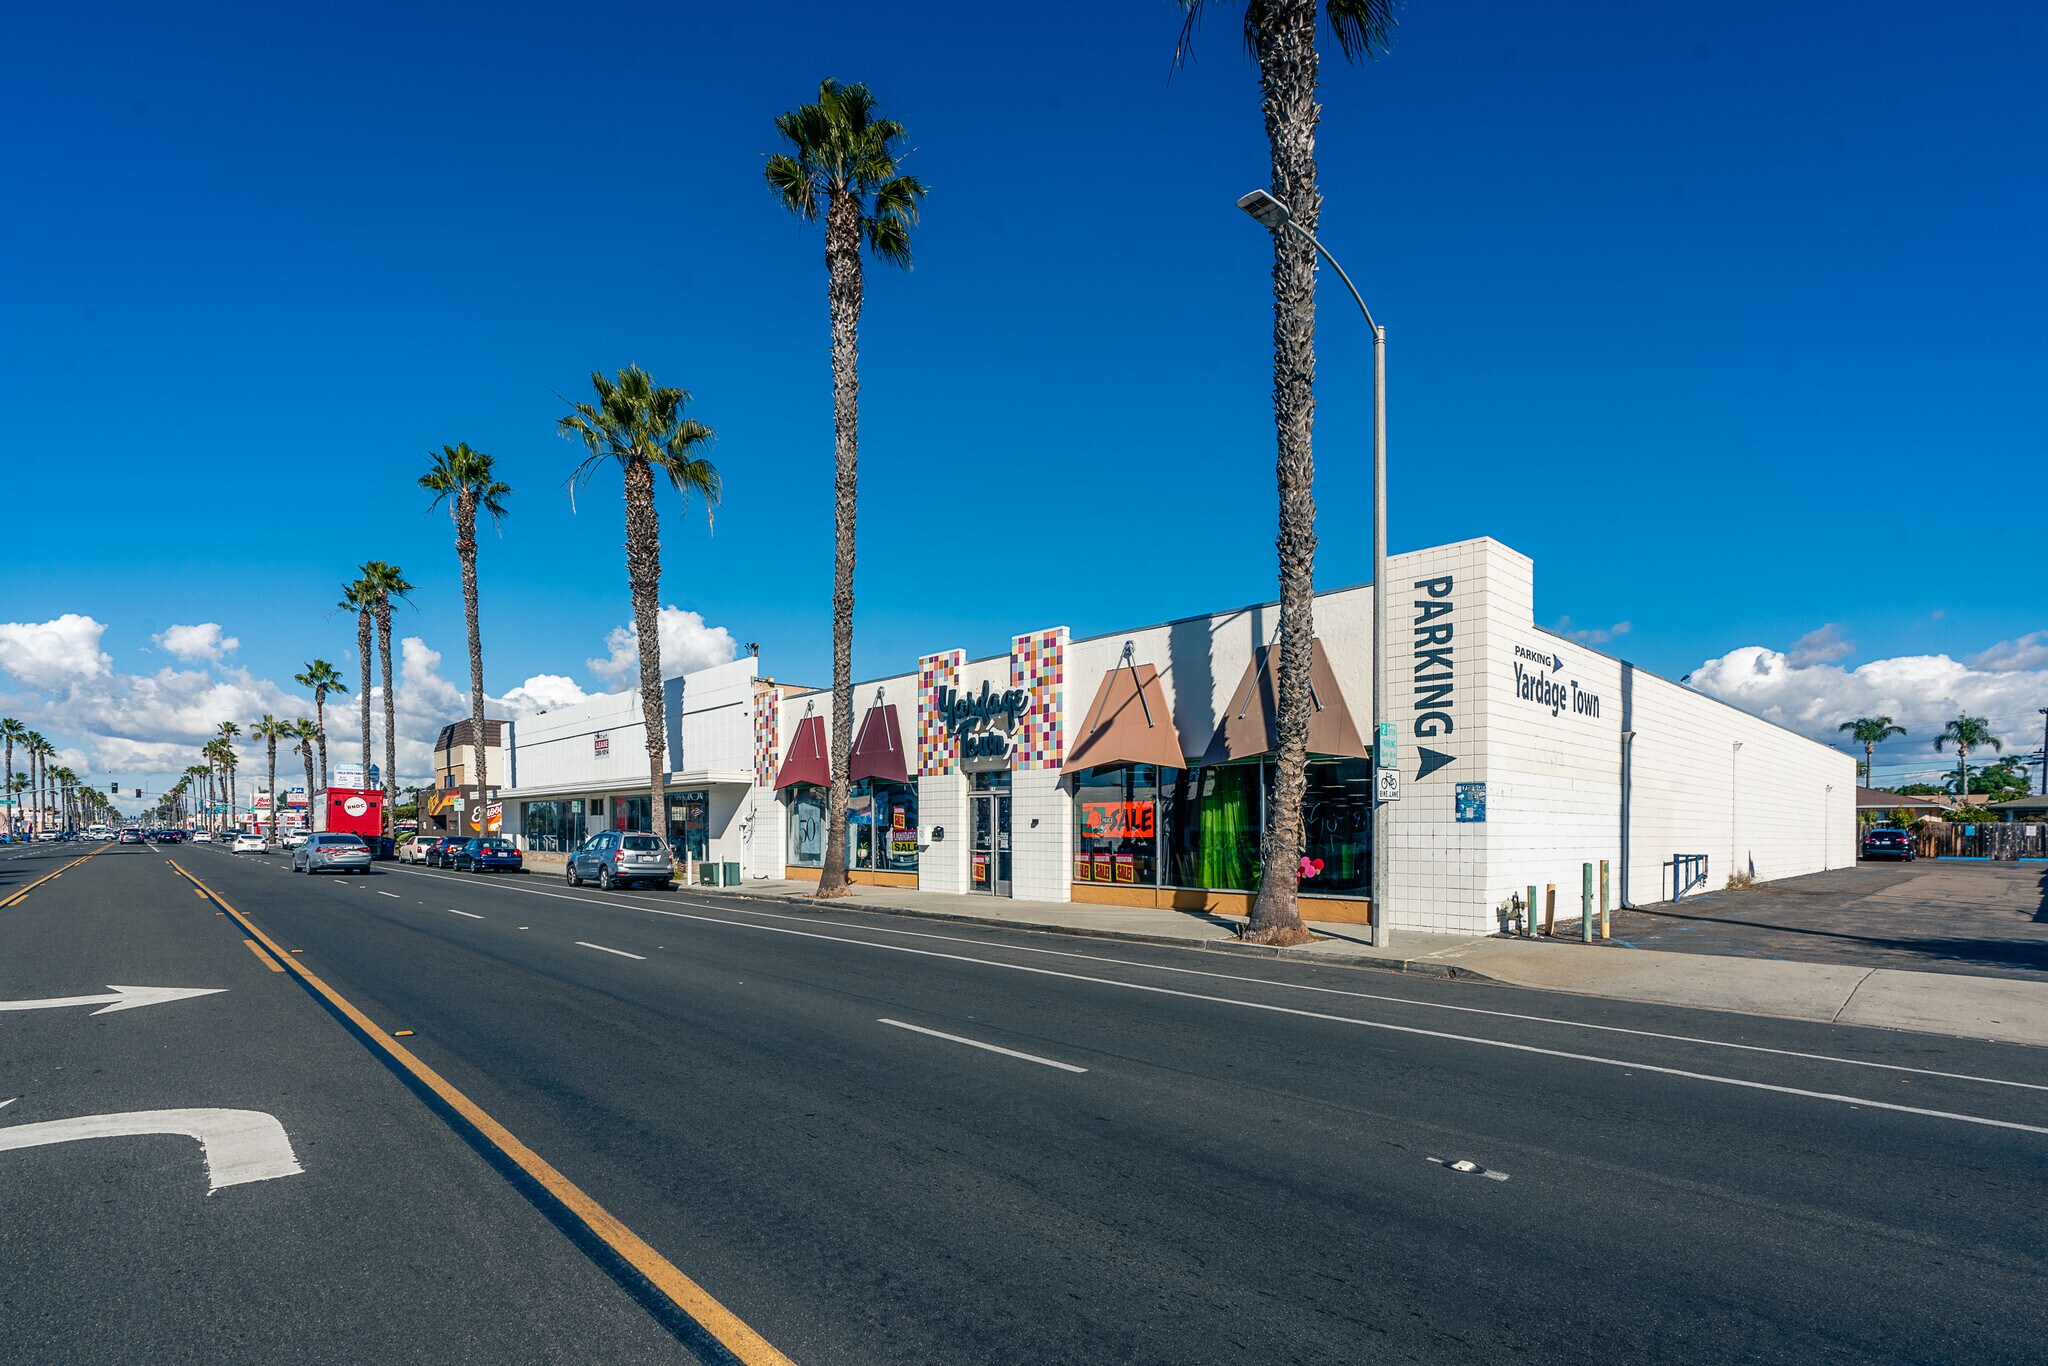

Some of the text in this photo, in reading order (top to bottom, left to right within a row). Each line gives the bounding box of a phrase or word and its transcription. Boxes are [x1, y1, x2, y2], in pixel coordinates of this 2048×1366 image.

[1414, 575, 1454, 738] PARKING
[1515, 645, 1551, 667] PARKING
[1513, 661, 1600, 719] Yardage Town
[938, 679, 1029, 738] Yardage
[596, 740, 609, 748] LEASE
[956, 717, 1010, 758] Town
[1380, 790, 1399, 798] BIKE LANE
[1109, 808, 1153, 833] SALE
[893, 831, 918, 841] LIQUIDATIO
